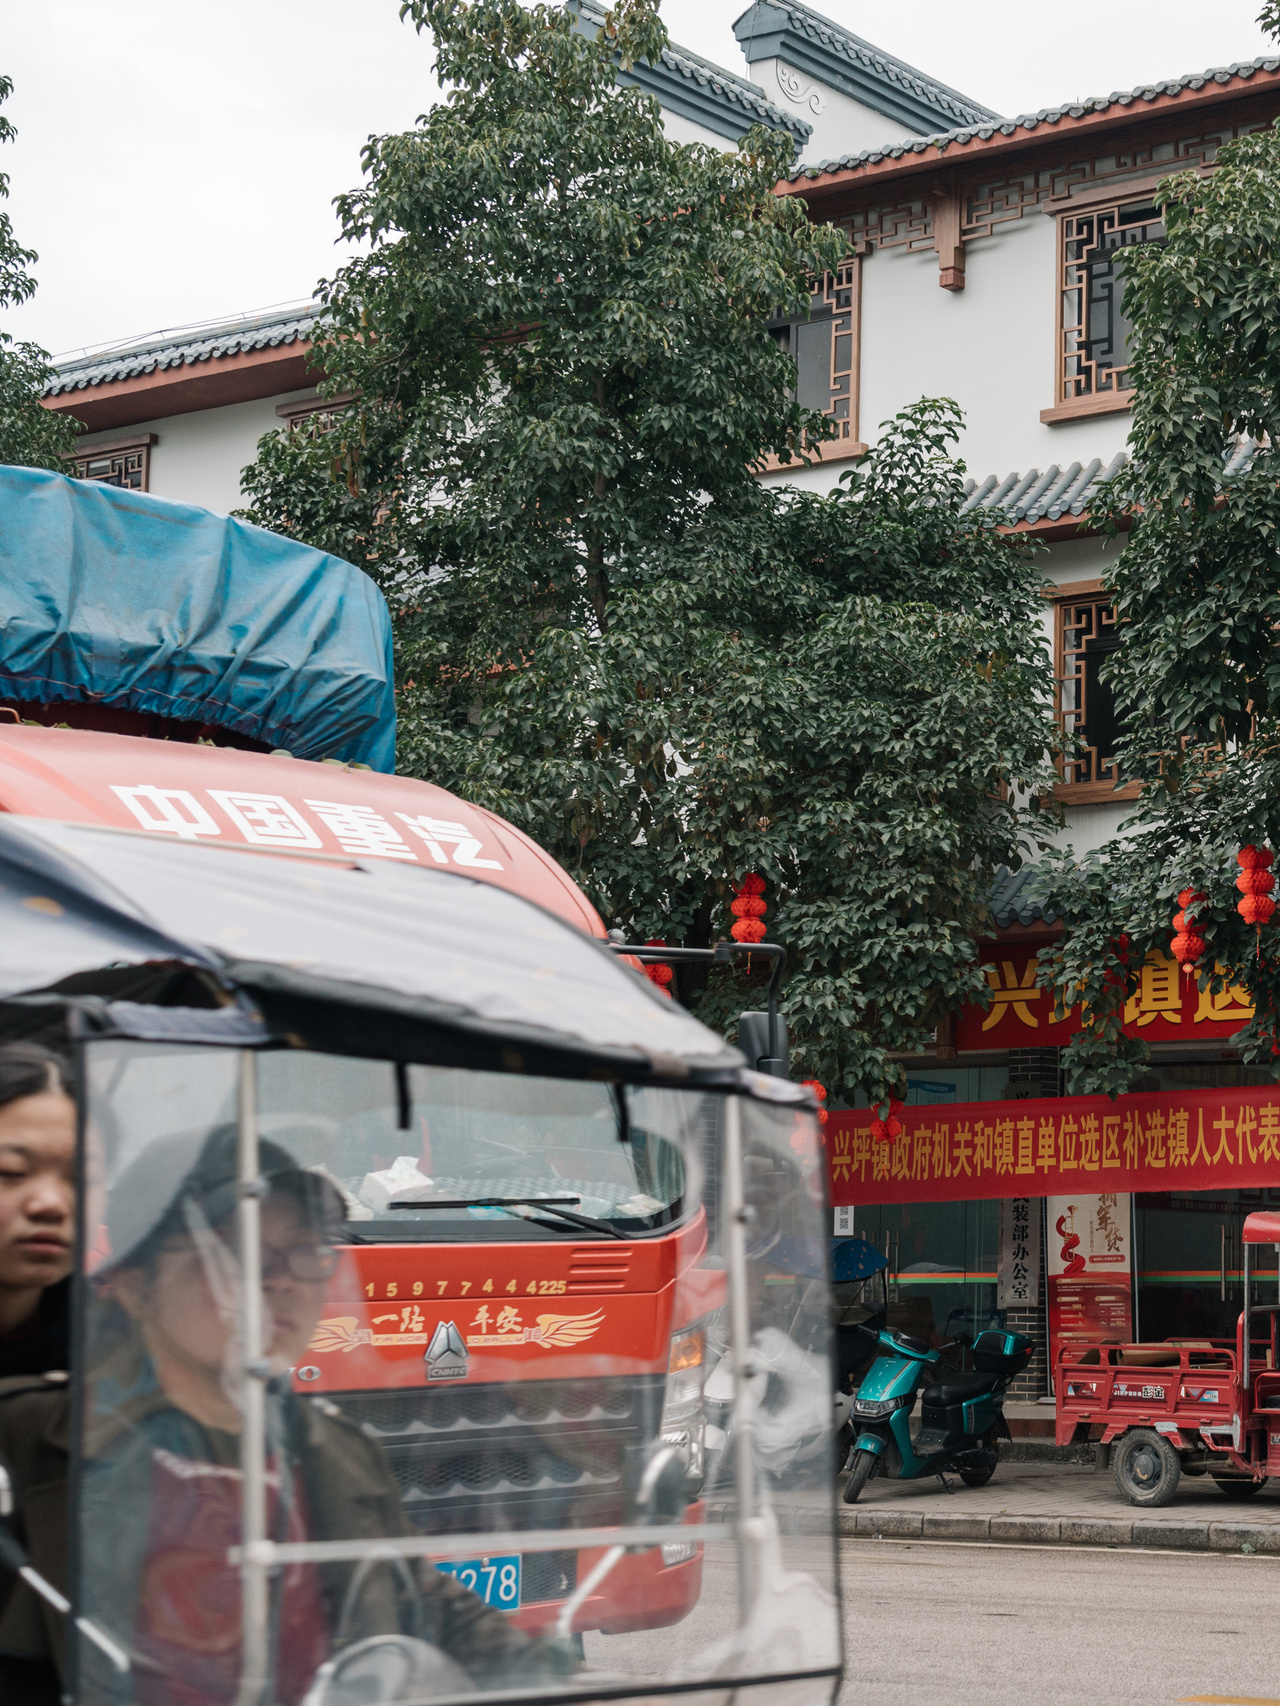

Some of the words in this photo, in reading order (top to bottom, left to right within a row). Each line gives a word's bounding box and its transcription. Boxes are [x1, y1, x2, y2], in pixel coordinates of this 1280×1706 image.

[109, 785, 504, 871] 中国重汽
[372, 1305, 425, 1333] 一路
[470, 1305, 524, 1333] 平安
[431, 1367, 466, 1376] CNHTC
